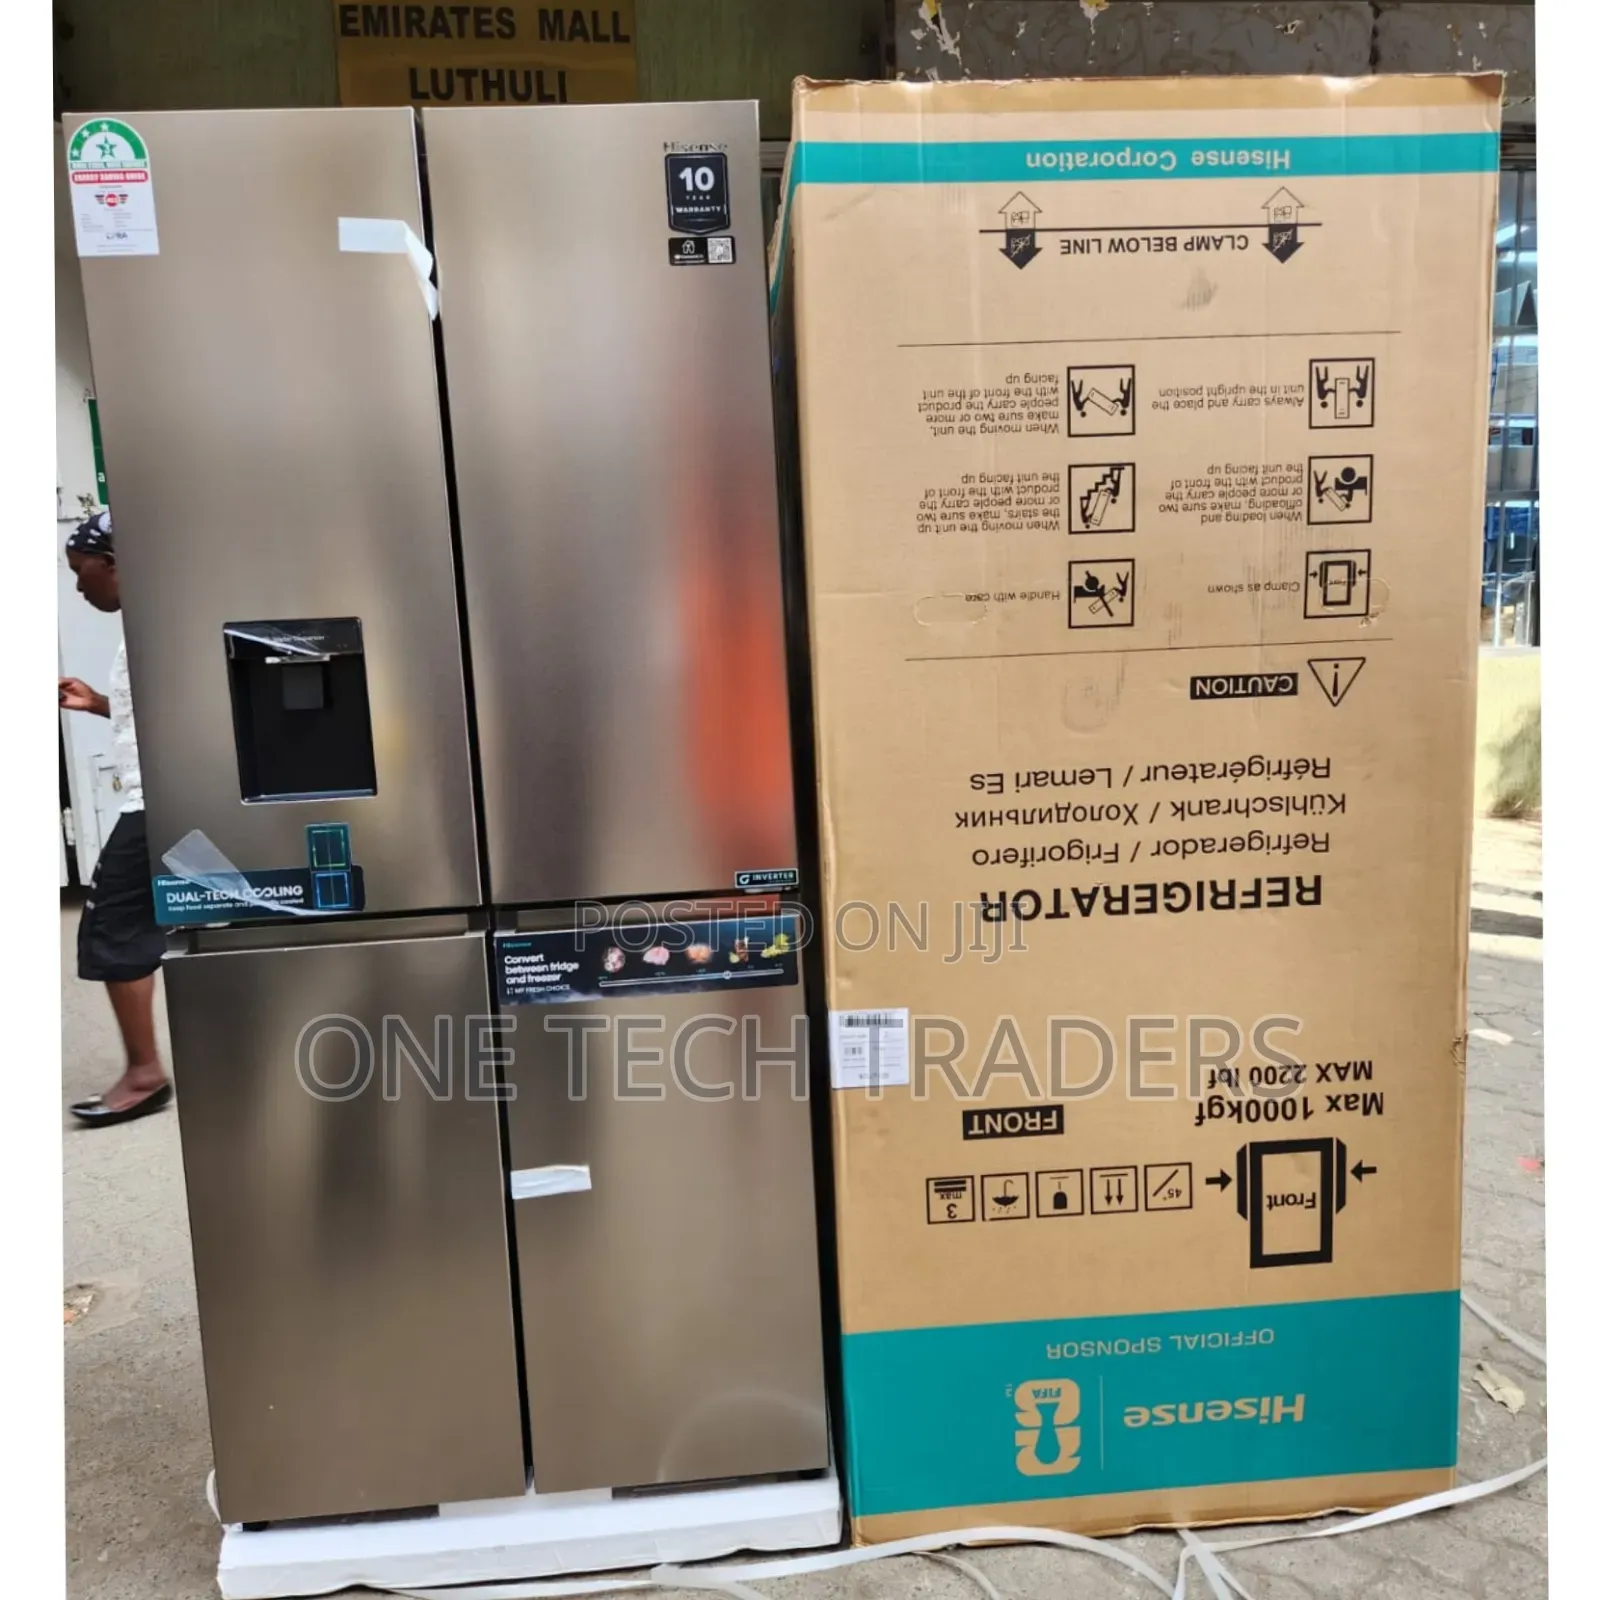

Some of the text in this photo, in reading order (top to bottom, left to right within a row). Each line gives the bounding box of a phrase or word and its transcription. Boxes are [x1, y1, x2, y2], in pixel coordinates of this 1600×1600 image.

[339, 4, 630, 43] EMIRATES MALL
[409, 67, 568, 103] LUTHULI
[1026, 148, 1290, 172] Hisense Corporation
[679, 166, 715, 191] 10
[675, 205, 721, 213] WARRANTY
[1060, 234, 1249, 255] CLAMP BELOW LINE
[1005, 373, 1059, 385] facing up
[923, 385, 1059, 401] with the front of the unit
[1159, 384, 1304, 398] unit in the upright position
[918, 397, 1059, 413] people carry the product
[1152, 397, 1304, 411] Always carry and place the
[926, 411, 1059, 424] make sure two or more
[930, 423, 1059, 437] When moving the unit,
[1207, 464, 1304, 477] the unit facing up
[961, 472, 1060, 485] the unit facing up
[1170, 475, 1303, 491] product with the front of
[924, 484, 1060, 500] product with the front of
[1165, 487, 1303, 502] or more people carry the
[919, 496, 1060, 511] or more people carry the
[1158, 504, 1179, 513] two
[1181, 502, 1207, 512] sure
[1210, 502, 1241, 513] make
[916, 508, 1060, 523] the stairs, make sure two
[1201, 511, 1302, 525] When loading and
[918, 520, 1060, 534] When moving the unit up
[1208, 581, 1300, 594] Clamp as shown
[993, 592, 1016, 602] with
[1020, 591, 1060, 601] Handle
[1195, 676, 1293, 696] CAUTION
[970, 755, 1331, 794] Réfrigérateur / Lemari Es
[955, 793, 1346, 828] Kühlschrank / Холодильник
[972, 830, 1330, 868] Refrigerador / Frigorifero
[752, 872, 794, 881] INVERTER
[166, 889, 239, 903] DUAL-TECH
[980, 875, 1322, 922] REFRIGERATOR
[504, 953, 545, 965] Convert
[505, 962, 580, 975] between fridge
[506, 973, 562, 985] and freezer
[1208, 1060, 1374, 1089] MAX 2200 lbf
[1194, 1092, 1385, 1127] Max 1000kgf
[968, 1109, 1058, 1136] FRONT
[939, 1190, 962, 1201] max
[1265, 1190, 1317, 1210] Front
[946, 1203, 958, 1219] 3
[1046, 1328, 1275, 1360] OFFICIAL SPONSOR
[1031, 1387, 1062, 1399] FIFA
[1123, 1393, 1305, 1429] Hisense
